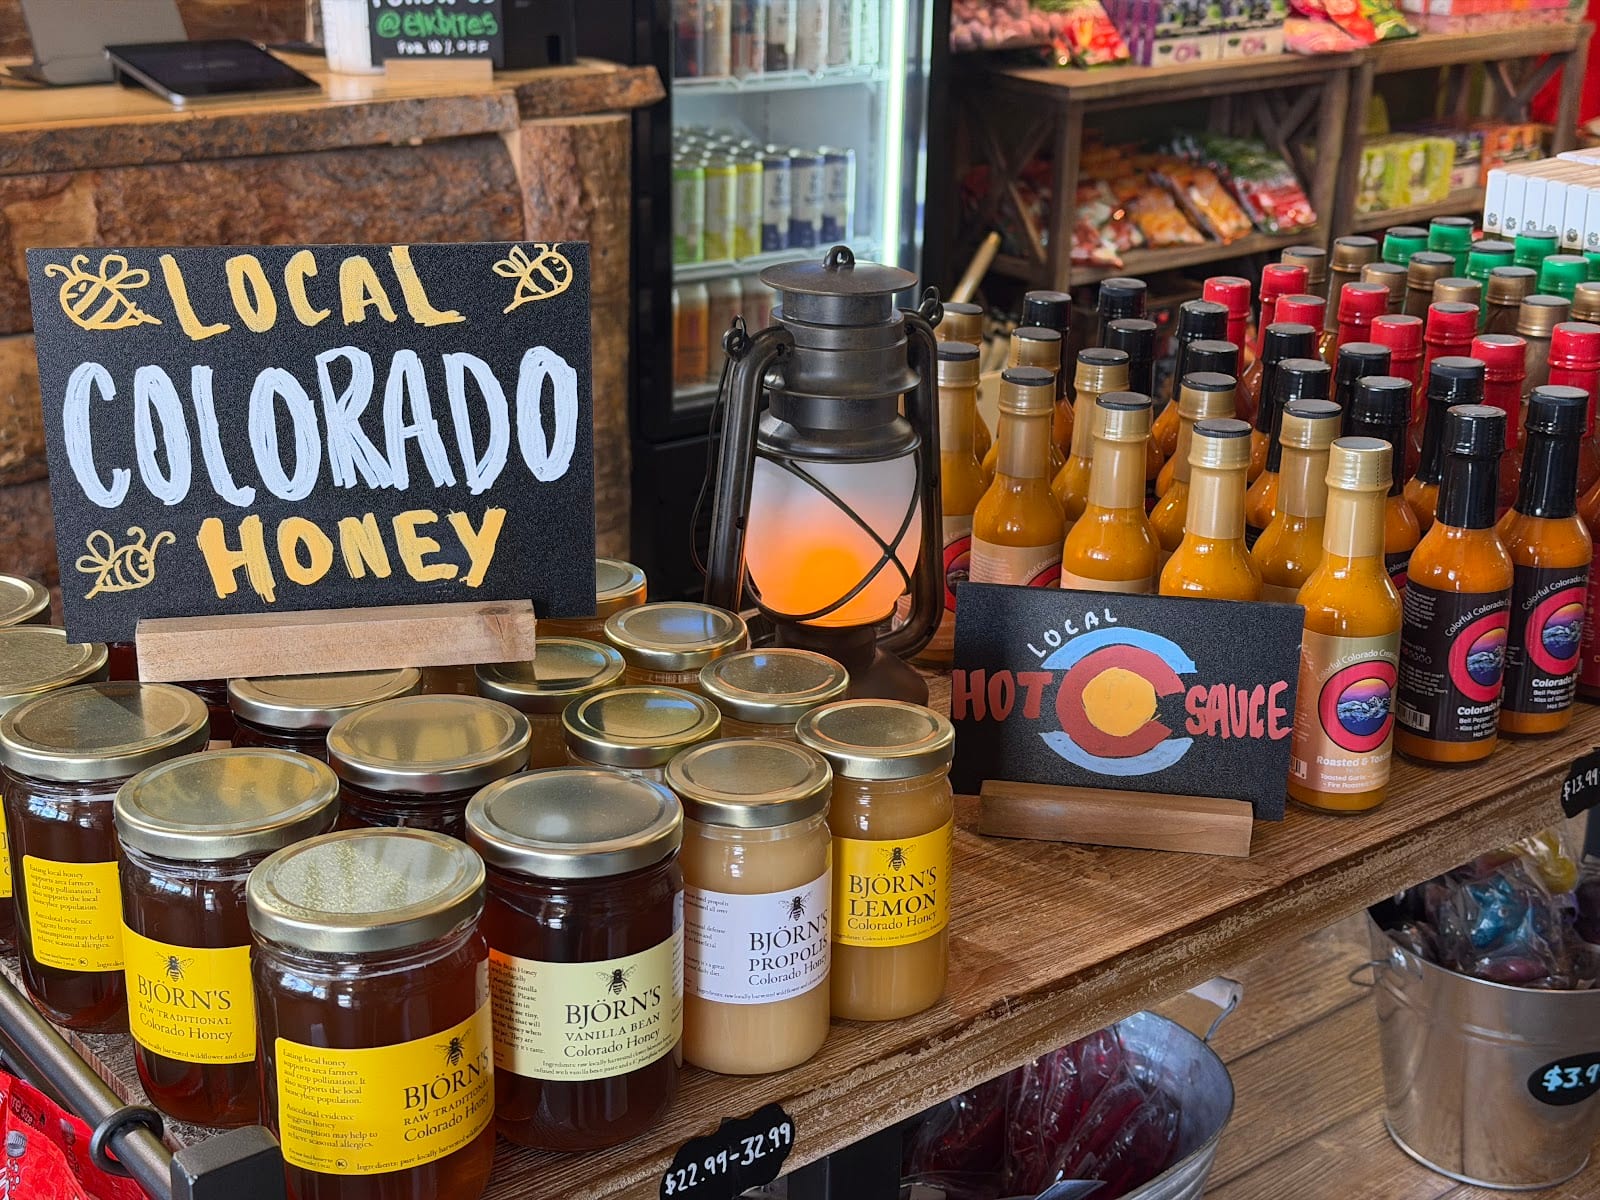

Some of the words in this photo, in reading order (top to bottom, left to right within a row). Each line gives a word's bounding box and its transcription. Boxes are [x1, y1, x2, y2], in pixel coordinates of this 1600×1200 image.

[397, 40, 426, 54] FOR
[456, 41, 490, 54] OFF
[159, 245, 467, 341] LOCAL
[62, 345, 578, 509] COLORADO
[195, 507, 507, 603] HONEY
[1522, 586, 1549, 610] Colorful
[1550, 575, 1582, 591] Colorado
[1445, 611, 1473, 637] Colorful
[1473, 599, 1506, 616] Colorado
[1027, 608, 1117, 658] LOCAL
[1342, 649, 1379, 664] Colorado
[1532, 675, 1572, 687] Colorado
[951, 668, 1053, 721] HOT
[1184, 679, 1294, 740] SAUCE
[1457, 702, 1497, 716] Colorado
[1316, 755, 1360, 767] Roasted
[1320, 773, 1347, 781] Toasted
[1563, 768, 1598, 801] $13.99
[47, 868, 61, 877] local
[62, 870, 84, 879] honey
[68, 879, 94, 887] farmers
[848, 866, 937, 899] BJÖRN'S
[848, 889, 937, 918] LEMON
[57, 924, 77, 932] honey
[748, 908, 828, 956] BJÖRN'S
[847, 917, 903, 931] Colorado
[907, 911, 937, 927] Honey
[89, 932, 105, 942] help
[748, 933, 828, 972] PROPOLIS
[748, 967, 802, 986] Colorado
[804, 955, 827, 975] Honey
[137, 973, 232, 1010] BJÖRN'S
[139, 1000, 155, 1014] RAW
[156, 1009, 232, 1026] TRADITIONAL
[565, 985, 661, 1029] BJÖRN'S
[140, 1012, 185, 1037] Colorado
[186, 1027, 233, 1044] Honey
[565, 1026, 627, 1042] VANILLA
[630, 1012, 660, 1032] BEAN
[564, 1041, 623, 1058] Colorado
[626, 1028, 660, 1049] Honey
[303, 1054, 320, 1065] local
[322, 1057, 346, 1069] honey
[328, 1067, 358, 1076] farmers
[296, 1073, 311, 1084] crop
[297, 1082, 327, 1094] supports
[343, 1087, 362, 1095] local
[403, 1046, 489, 1112] BJÖRN'S
[1541, 1063, 1600, 1092] $3.9
[404, 1111, 431, 1126] RAW
[433, 1075, 488, 1117] TRADITIONAL
[312, 1119, 336, 1129] honey
[404, 1113, 463, 1142] Colorado
[465, 1091, 489, 1119] Honey
[309, 1139, 339, 1148] seasonal
[332, 1132, 349, 1140] may
[349, 1130, 368, 1140] help
[665, 1122, 791, 1195] $22.99-32.99
